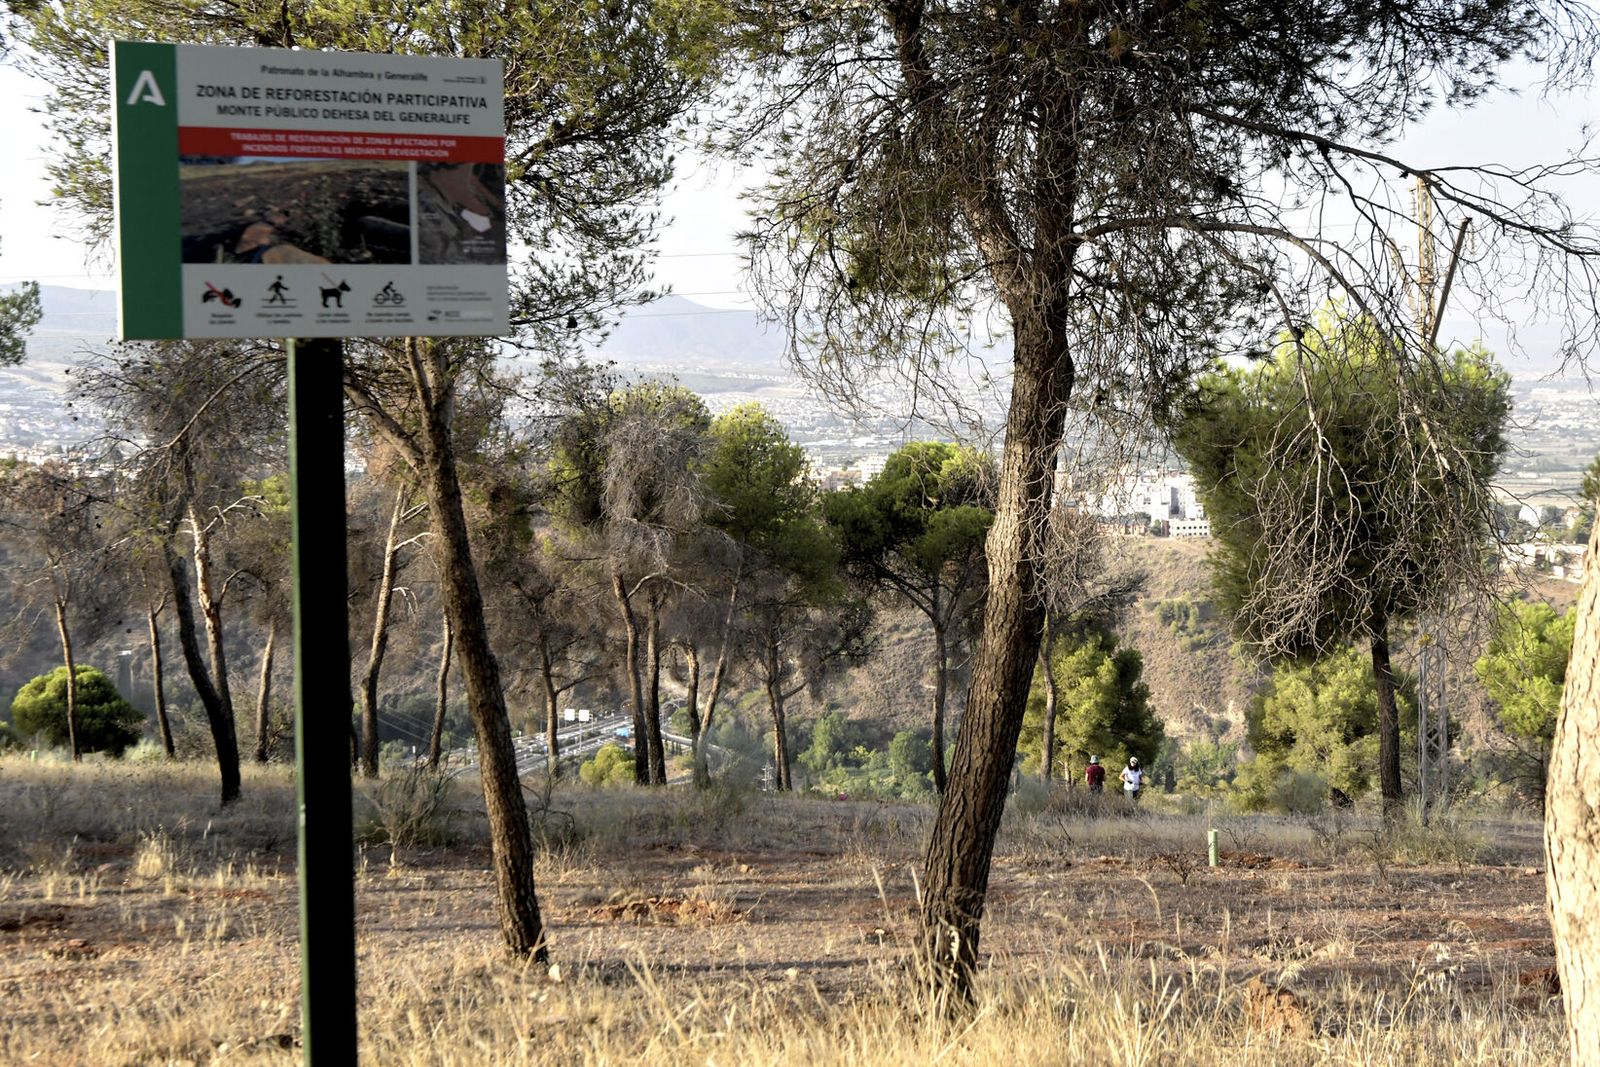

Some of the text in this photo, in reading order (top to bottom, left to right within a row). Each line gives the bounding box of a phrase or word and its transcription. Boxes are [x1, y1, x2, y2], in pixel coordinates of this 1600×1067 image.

[260, 64, 428, 82] Patronato de la Alhambra y Generalife
[196, 84, 488, 109] ZONA DE REFORESTACIÓN PARTICIPATIVA
[216, 104, 470, 125] MONTE PÚBLICO DEHESA DEL GENERALIFE
[440, 139, 456, 147] POR
